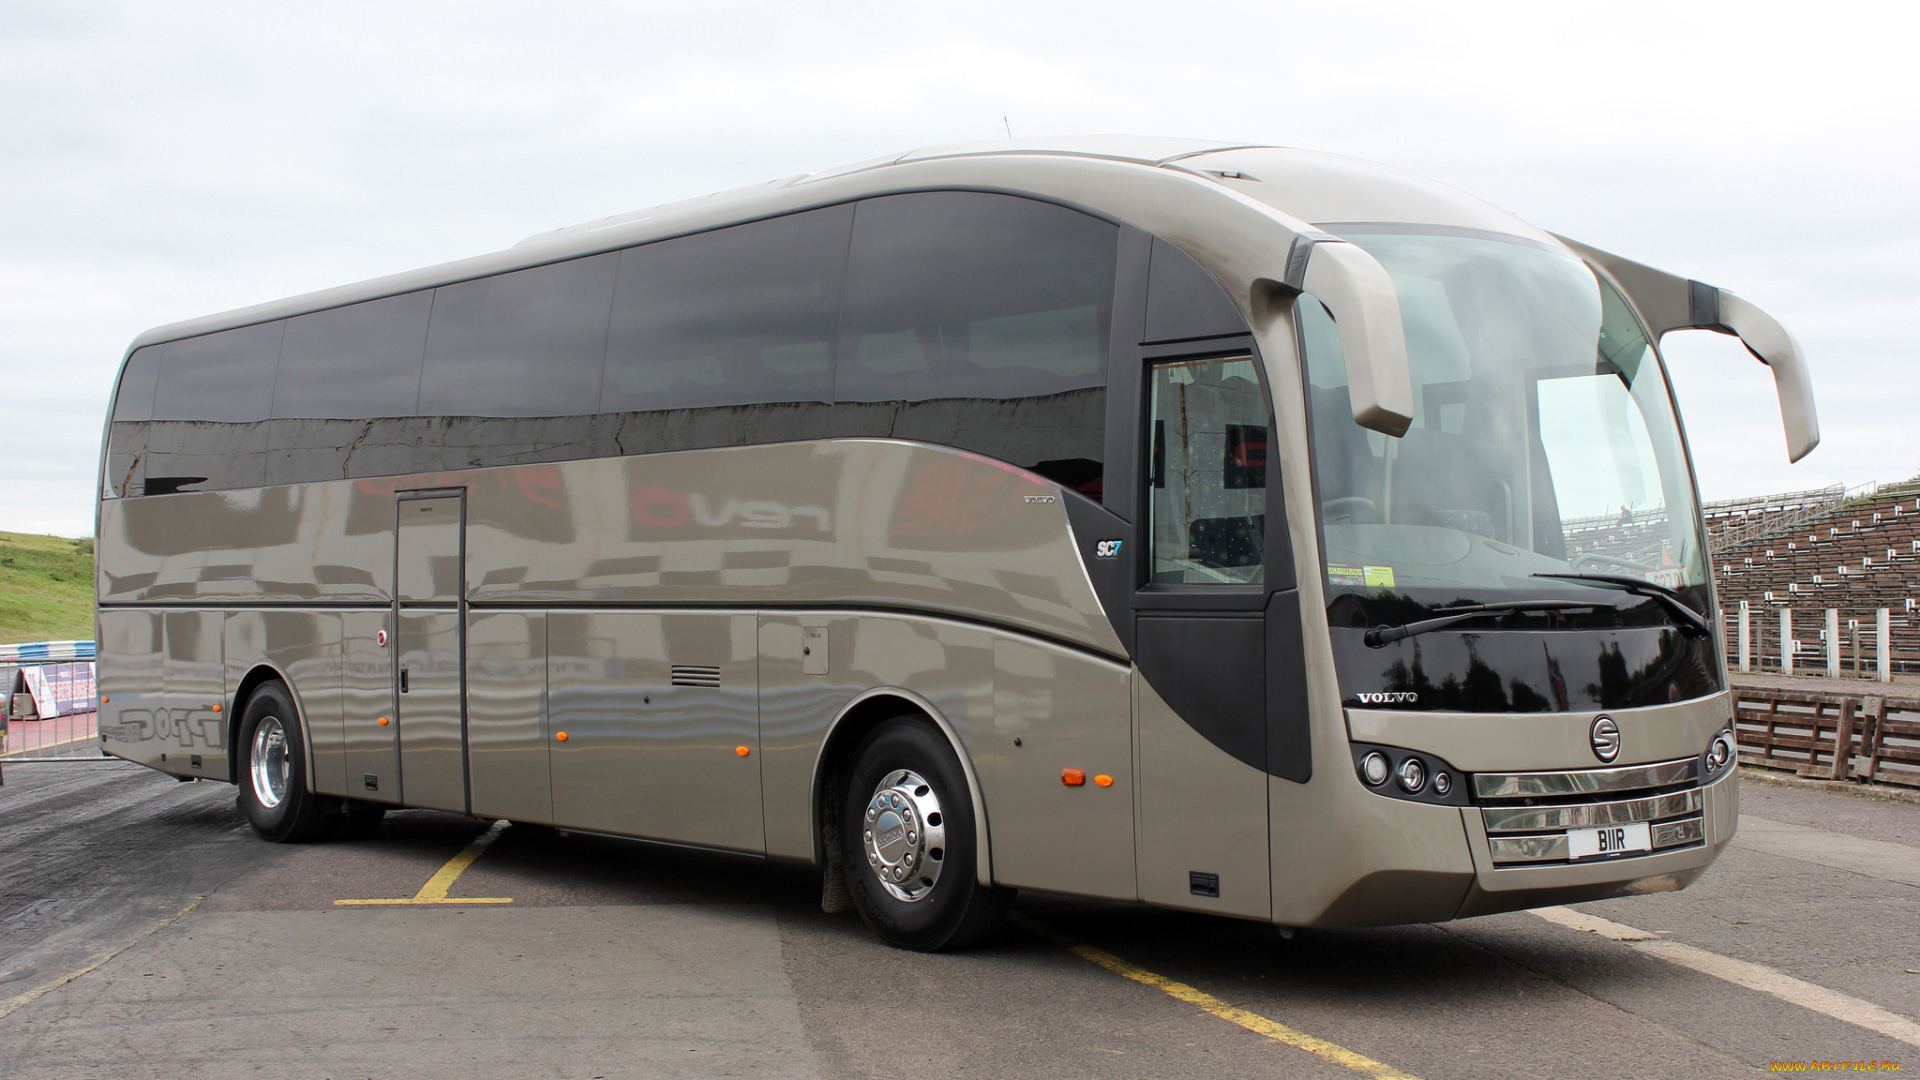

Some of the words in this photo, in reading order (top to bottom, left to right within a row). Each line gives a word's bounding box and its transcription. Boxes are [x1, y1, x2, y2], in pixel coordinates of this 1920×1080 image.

[1023, 495, 1056, 504] VOLVO
[1096, 540, 1123, 557] SC7
[1355, 692, 1419, 703] VOLVO
